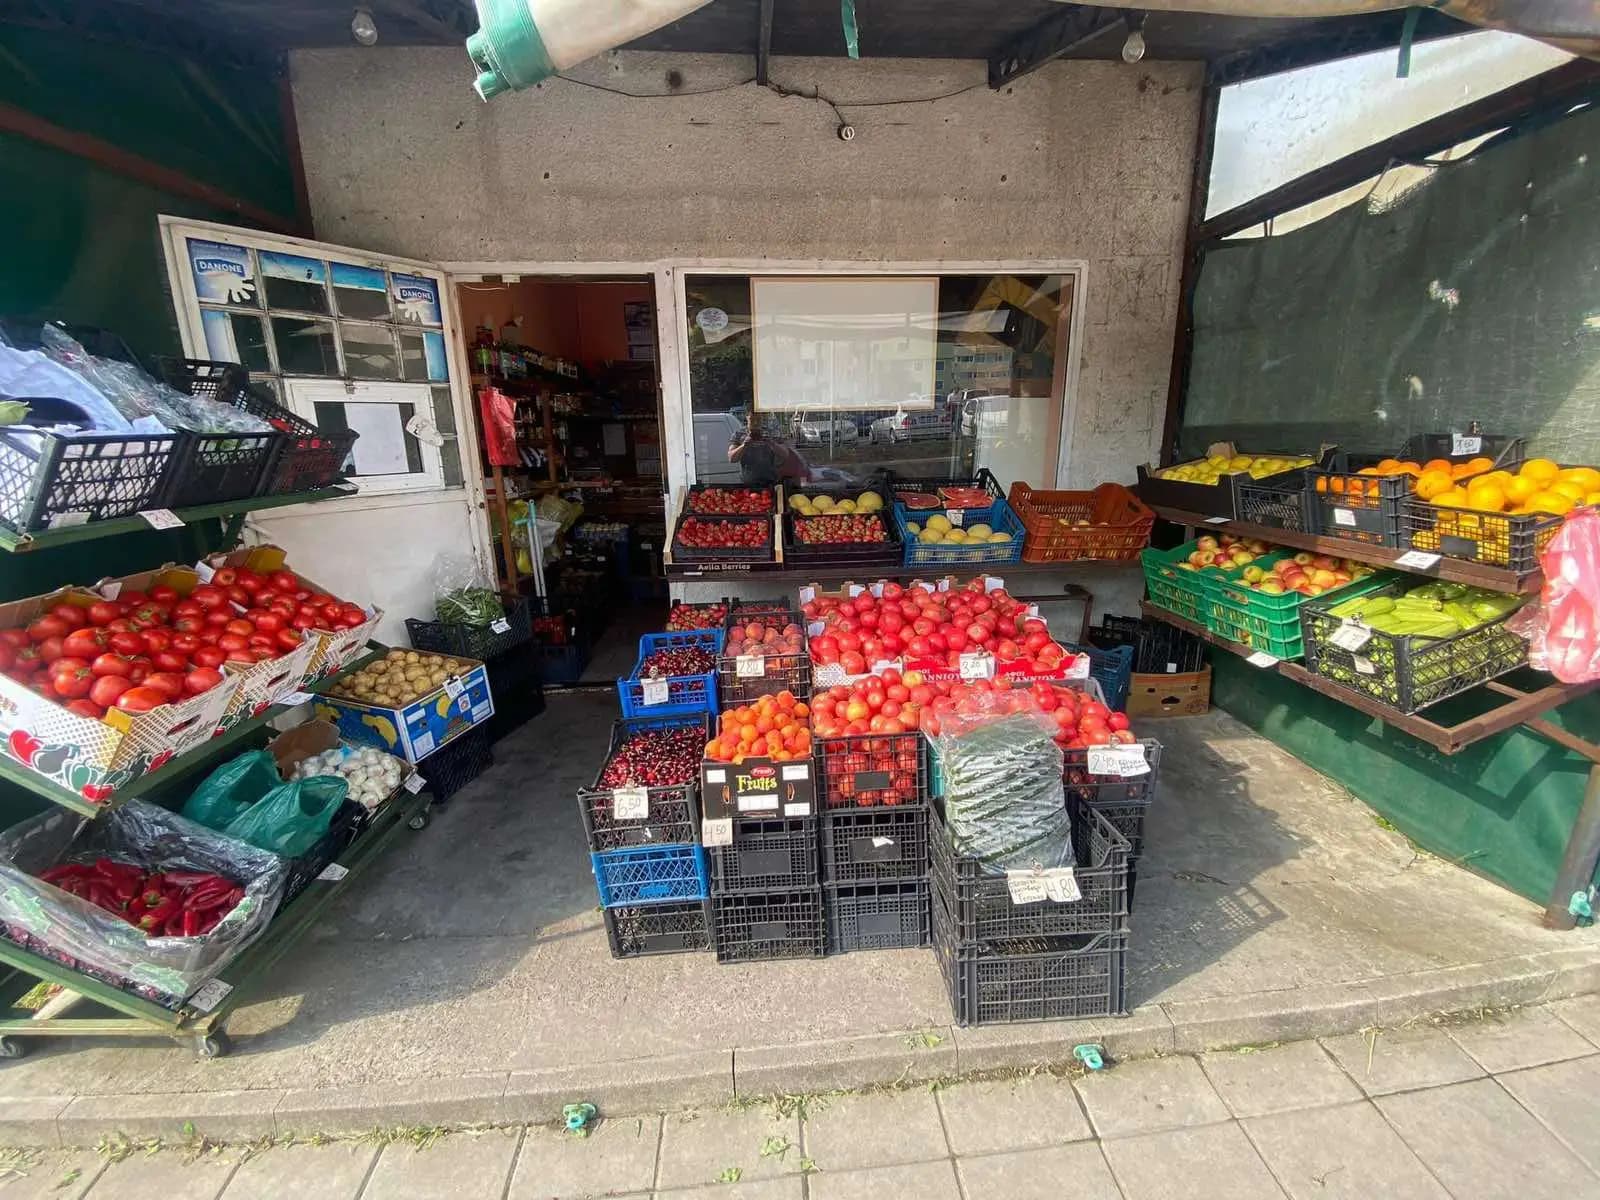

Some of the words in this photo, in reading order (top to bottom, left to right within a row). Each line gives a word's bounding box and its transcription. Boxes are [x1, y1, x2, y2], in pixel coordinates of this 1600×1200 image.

[199, 260, 242, 273] DANONE
[402, 289, 431, 300] DANONE
[721, 563, 751, 571] Berries
[735, 774, 778, 793] Fruits
